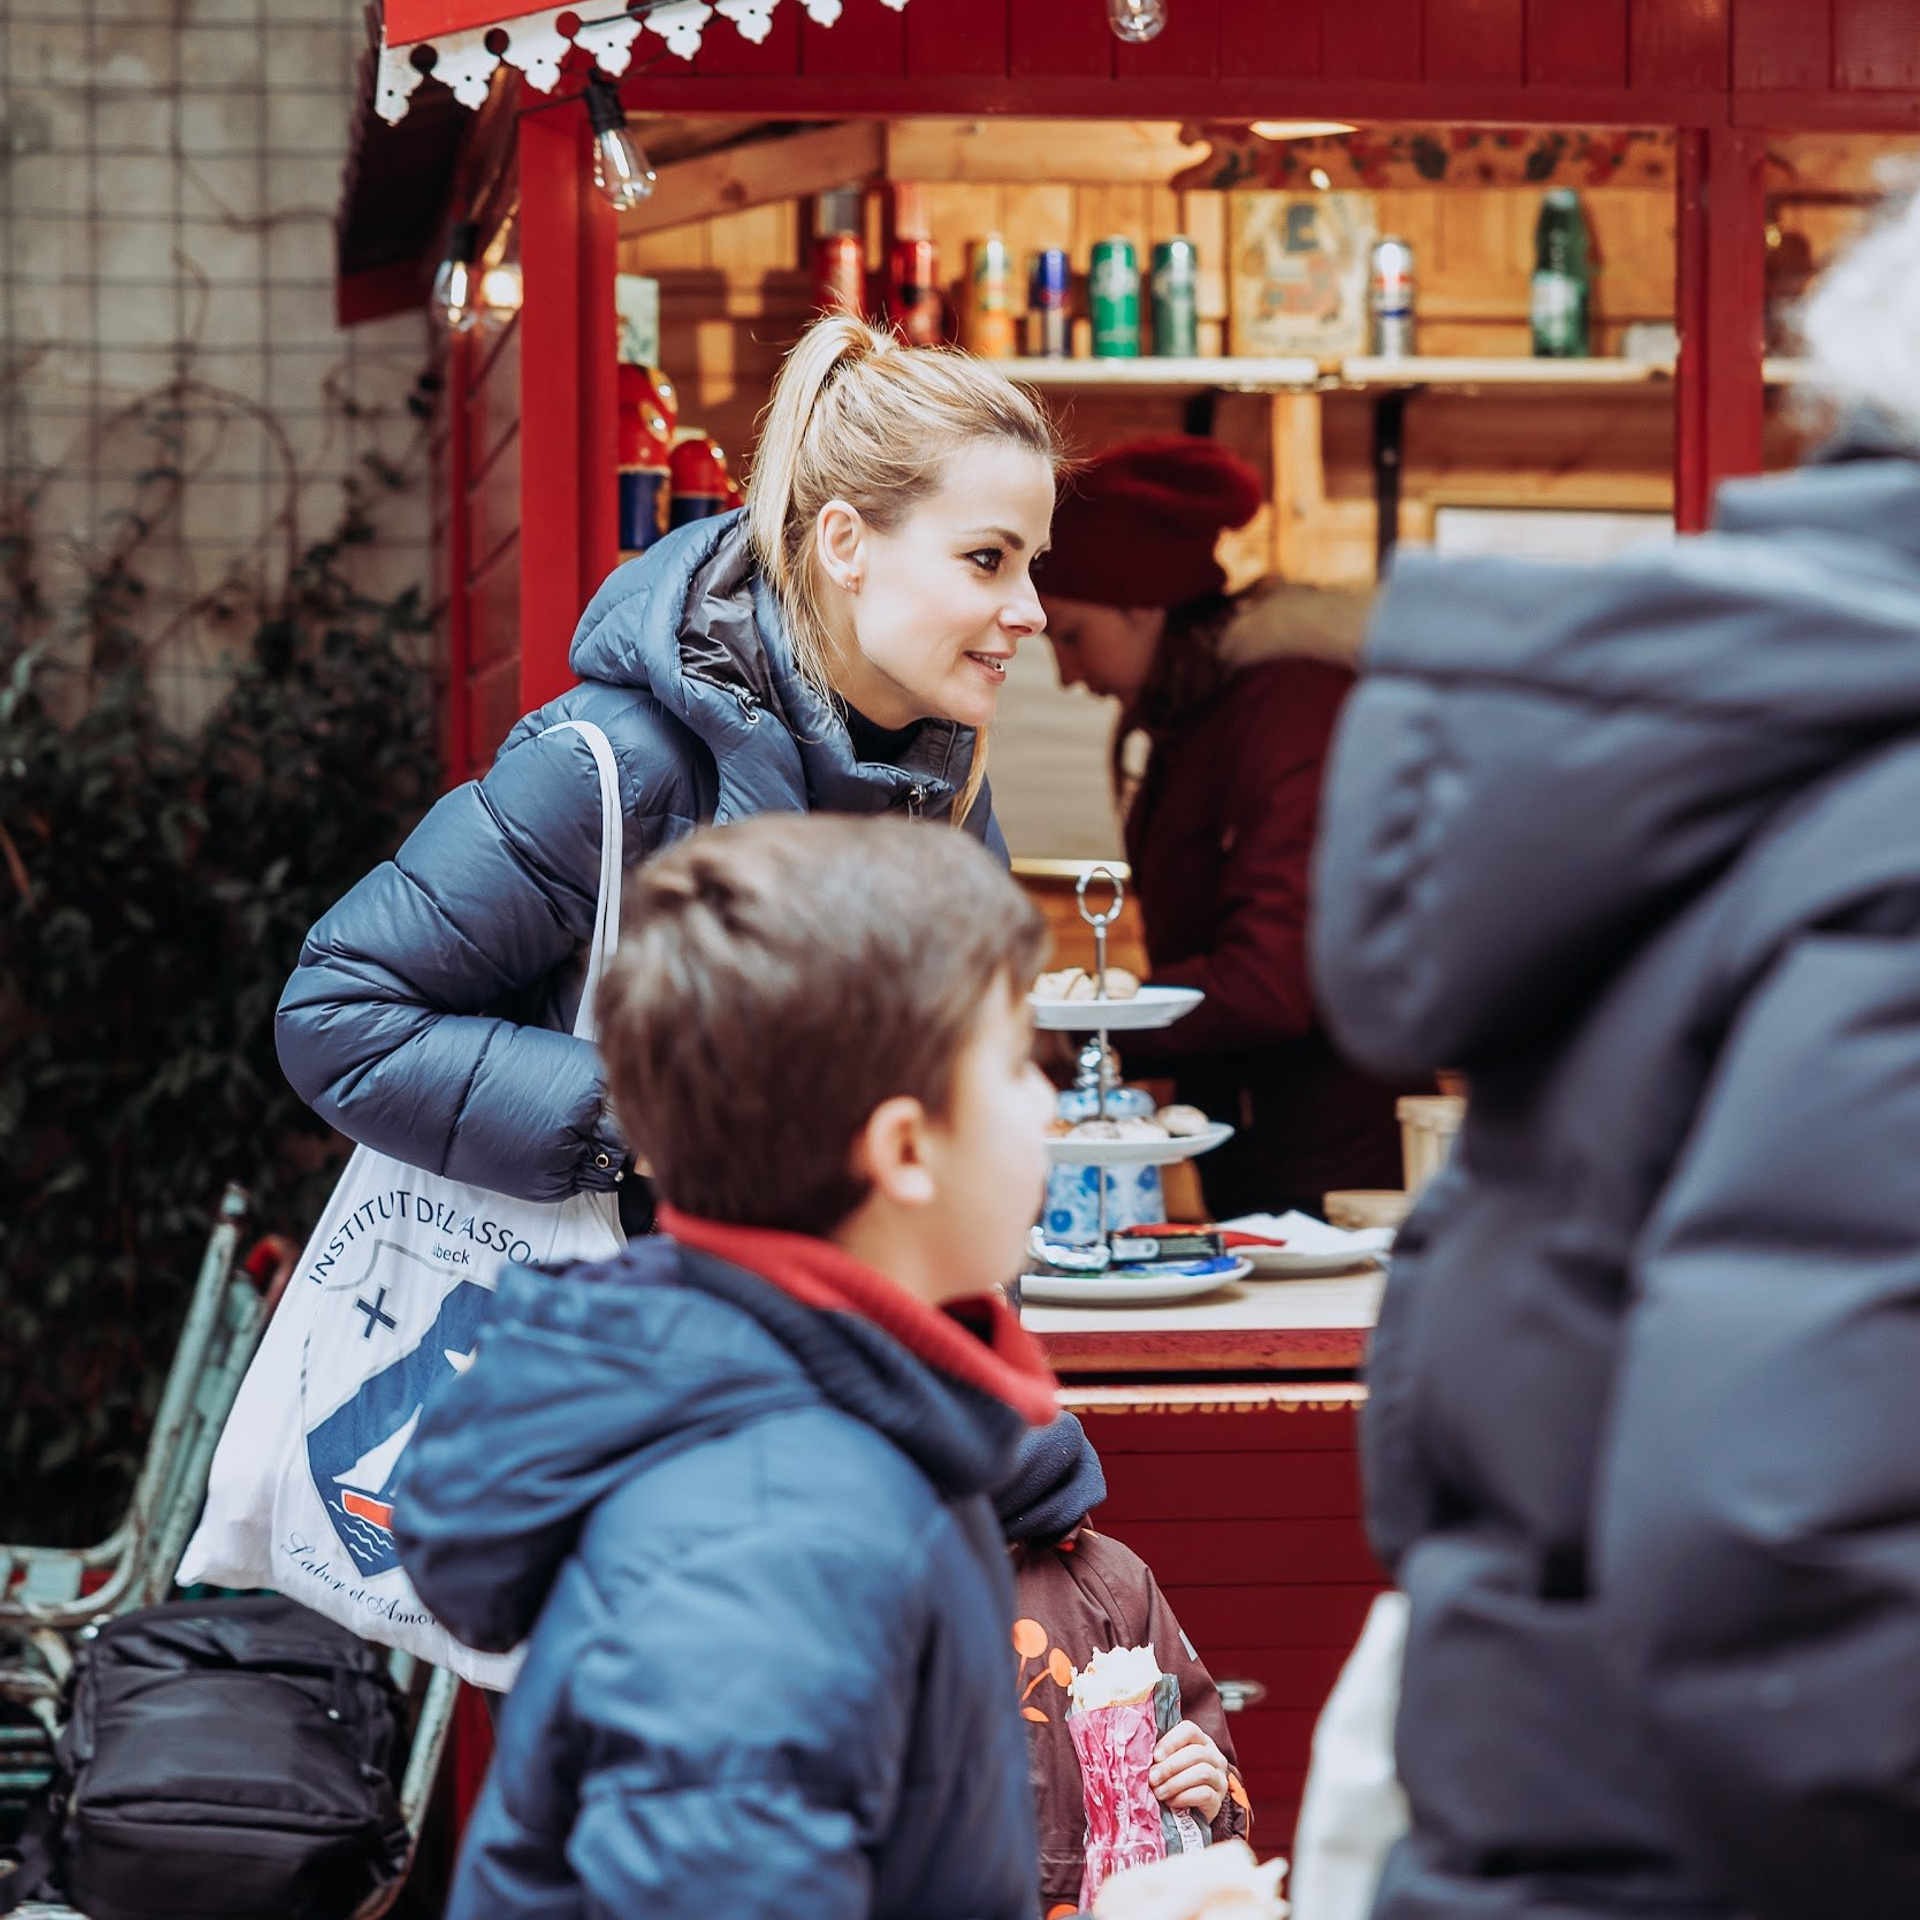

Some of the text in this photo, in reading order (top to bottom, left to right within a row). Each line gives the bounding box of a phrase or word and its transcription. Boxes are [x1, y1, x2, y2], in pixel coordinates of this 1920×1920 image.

[309, 1190, 411, 1284] INSTITUT
[280, 1531, 345, 1591] Labor
[349, 1588, 365, 1603] et
